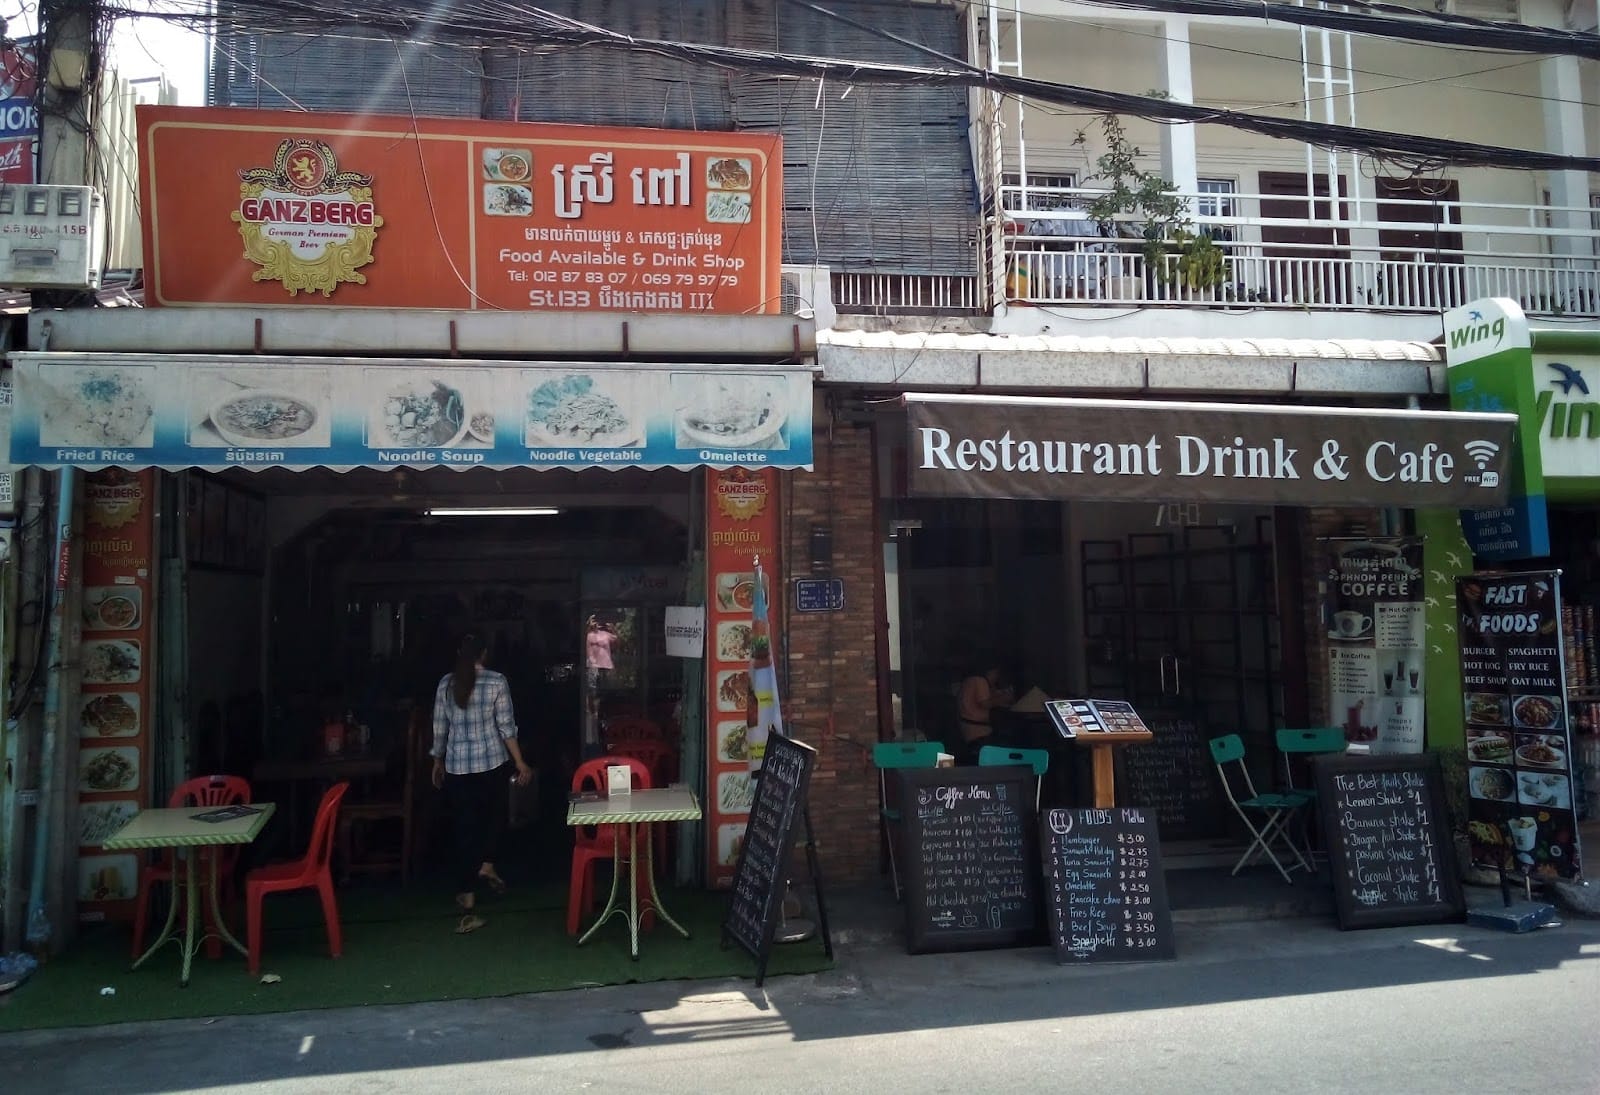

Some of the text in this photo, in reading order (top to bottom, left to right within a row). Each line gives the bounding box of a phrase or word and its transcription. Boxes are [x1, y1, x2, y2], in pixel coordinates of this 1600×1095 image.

[551, 152, 613, 218] ស្រី
[242, 200, 373, 224] GANZBERG
[269, 228, 348, 238] German Premium
[626, 231, 634, 244] &
[299, 240, 320, 249] Beer
[500, 249, 745, 270] Food Available & Drink Shop
[508, 271, 528, 282] Tel:
[533, 271, 556, 283] 012
[562, 272, 579, 283] 87
[585, 272, 603, 283] 83
[609, 273, 627, 284] 07
[642, 274, 671, 285] 069
[676, 275, 693, 286] 79
[698, 275, 716, 286] 97
[721, 276, 738, 287] 79
[529, 290, 590, 307] St.133
[690, 293, 714, 310] III
[1451, 317, 1504, 350] Wing
[57, 450, 135, 461] Fried Rice
[378, 450, 484, 463] Noodle Soup
[530, 450, 642, 463] Noodle Vegetable
[699, 450, 768, 462] Omelette
[918, 428, 1454, 483] Restaurant Drink & Cafe
[718, 485, 766, 493] GANZBERG
[1340, 574, 1408, 582] PHNOM PENH
[1341, 583, 1409, 596] COFFEE
[1485, 585, 1527, 605] FAST
[1480, 613, 1539, 633] FOODS
[1508, 648, 1556, 656] SPAGHETTI
[1529, 663, 1549, 671] RICE
[1487, 677, 1506, 685] SOUP
[1511, 677, 1557, 687] OAT MILK
[1335, 775, 1355, 790] The
[1358, 774, 1378, 790] Best
[935, 785, 990, 809] Coffee Menu
[1346, 793, 1376, 807] Lemon
[1376, 791, 1404, 806] Shake
[1078, 810, 1112, 825] FOODS
[1344, 811, 1385, 830] Banana
[1061, 833, 1100, 847] Hamburger
[1065, 870, 1080, 883] Egg
[1357, 865, 1392, 886] Coconut
[1090, 906, 1106, 918] Rice
[1071, 919, 1091, 936] Beef
[1096, 921, 1117, 936] Soup
